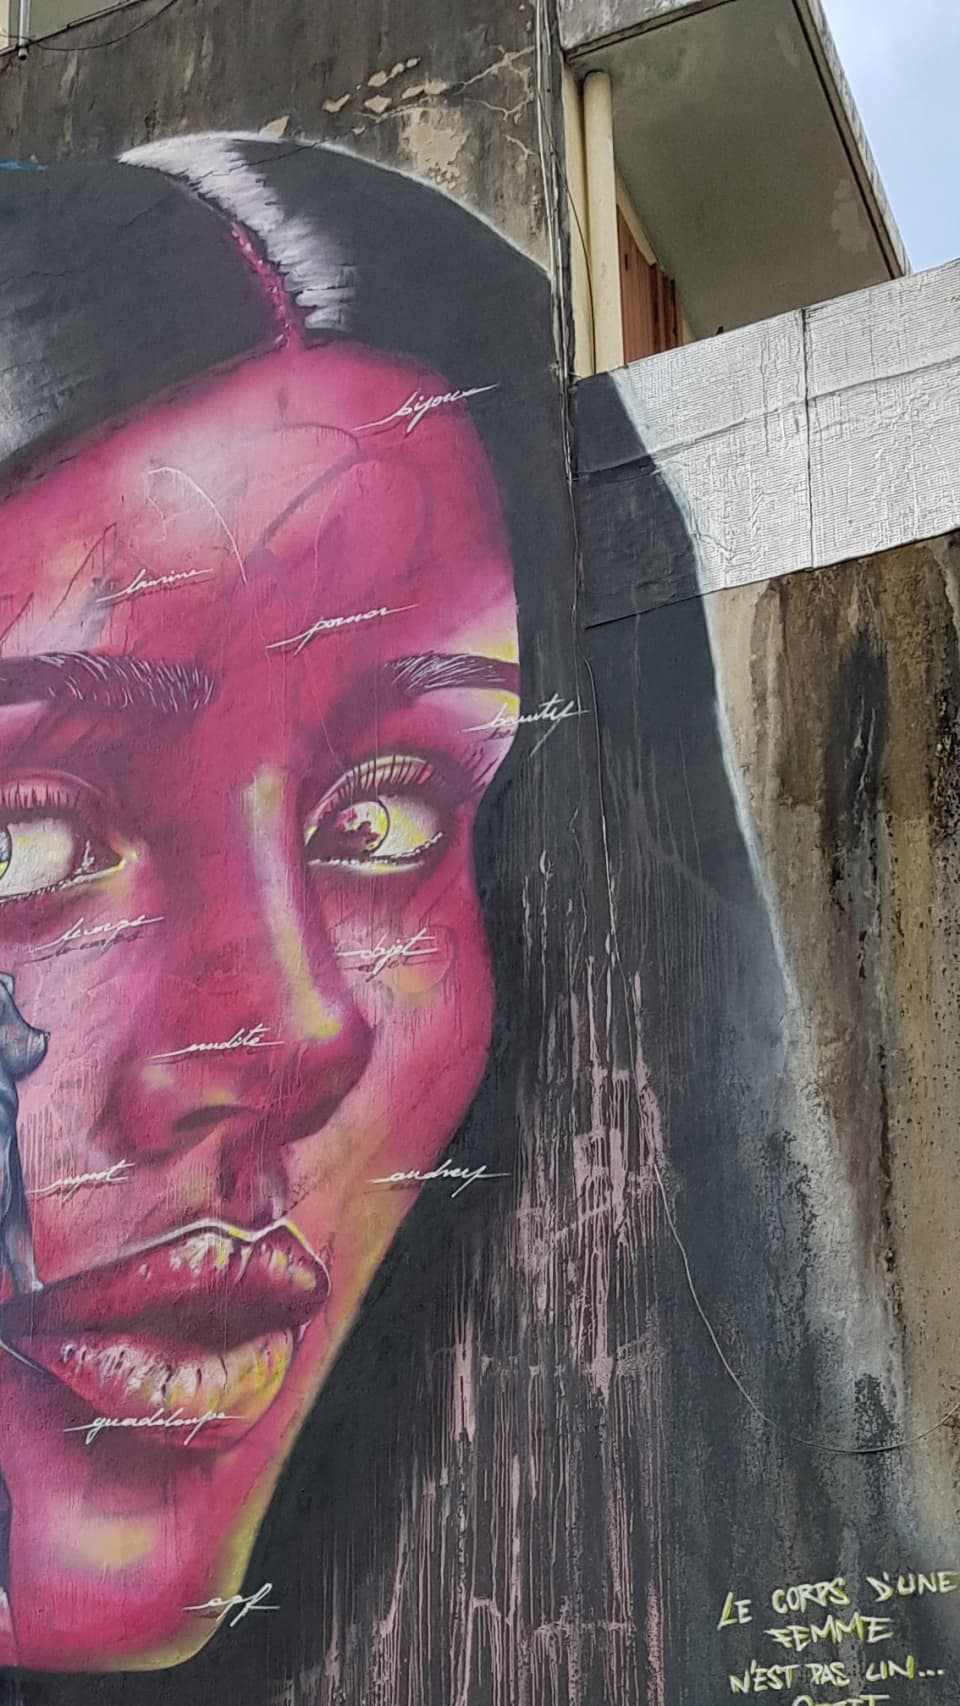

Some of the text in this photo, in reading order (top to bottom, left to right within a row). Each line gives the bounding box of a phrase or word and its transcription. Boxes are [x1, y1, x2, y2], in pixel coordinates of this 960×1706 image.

[717, 1571, 960, 1631] LE CORPS D'UNE
[764, 1612, 893, 1651] FEMME
[729, 1659, 800, 1694] N'EST
[805, 1661, 851, 1686] PAS
